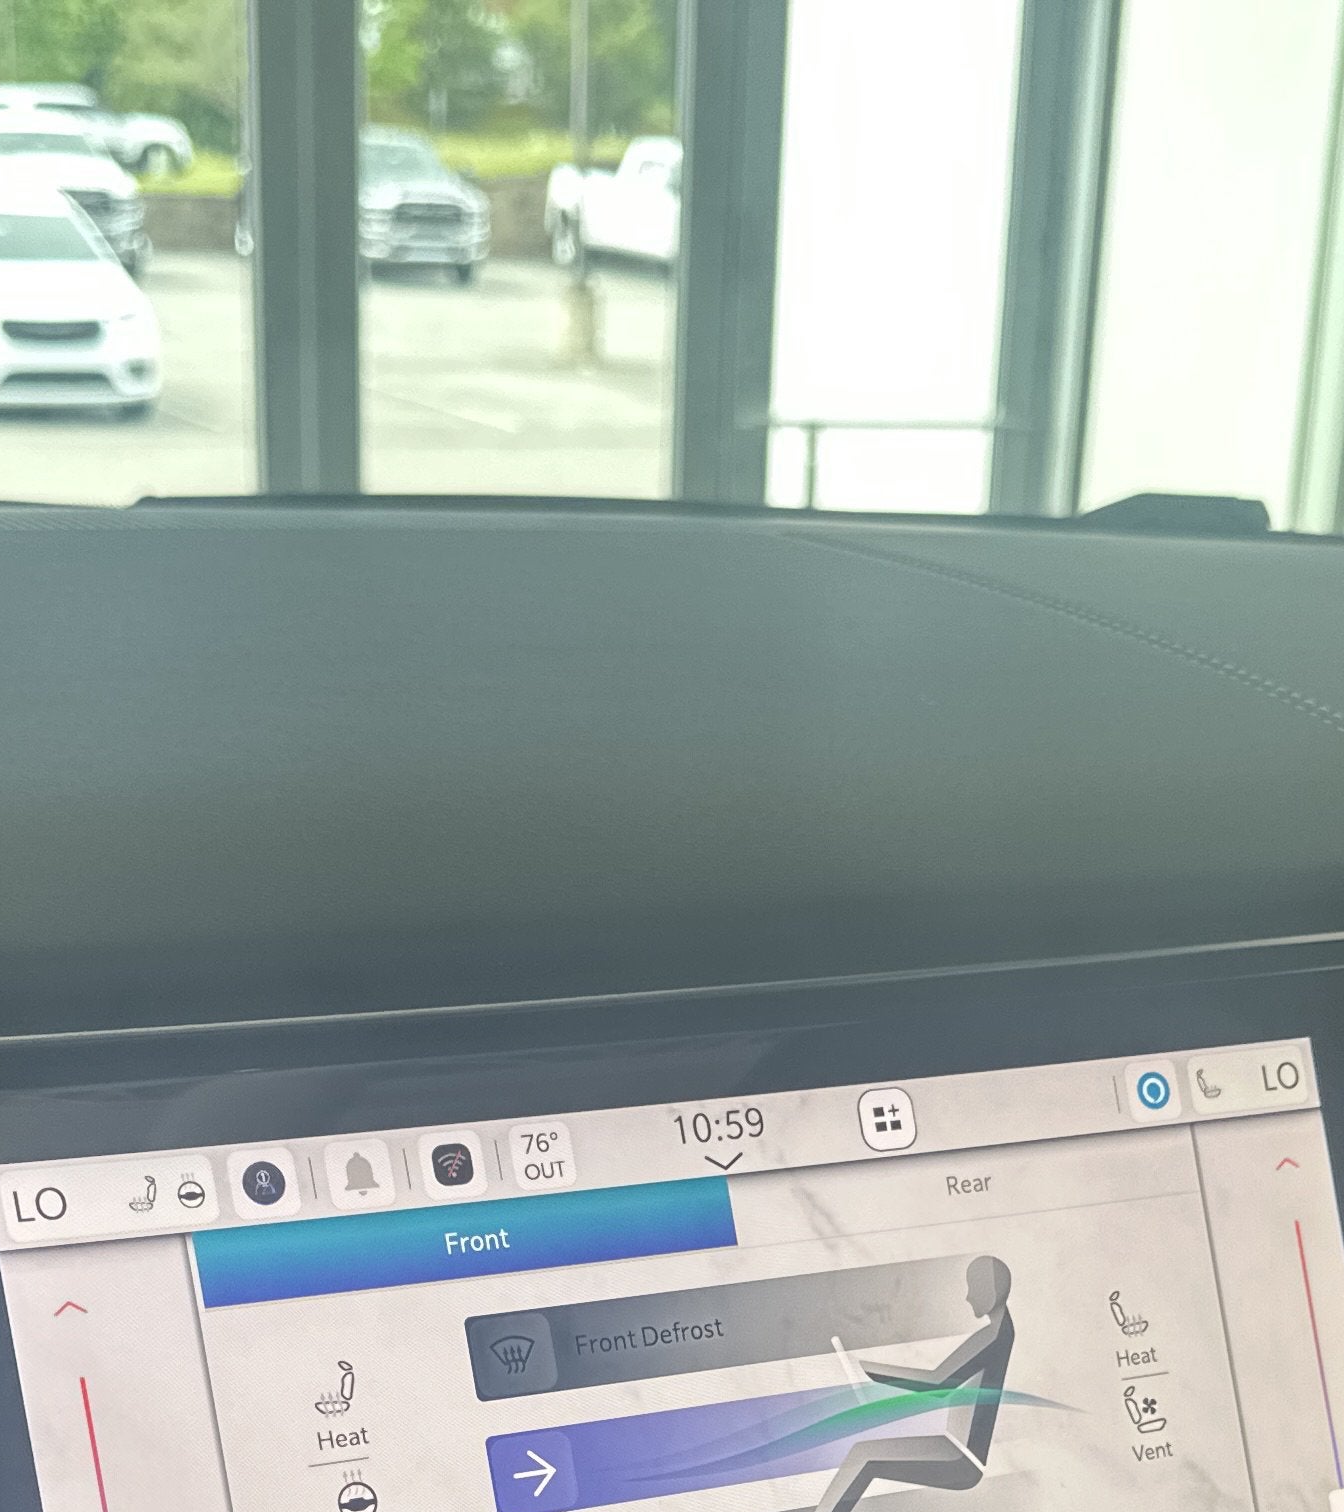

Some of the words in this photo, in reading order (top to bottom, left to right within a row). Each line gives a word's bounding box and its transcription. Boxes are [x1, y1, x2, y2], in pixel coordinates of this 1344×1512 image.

[1262, 1061, 1300, 1093] LO
[673, 1107, 765, 1145] 10:59
[520, 1131, 558, 1155] 76°
[524, 1159, 565, 1182] OUT
[946, 1172, 992, 1197] Rear
[12, 1187, 68, 1224] LO
[444, 1228, 511, 1255] Front
[575, 1329, 637, 1356] Front
[641, 1317, 725, 1347] Defrost
[1116, 1345, 1158, 1367] Heat
[316, 1426, 370, 1450] Heat
[1132, 1441, 1174, 1462] Vent
